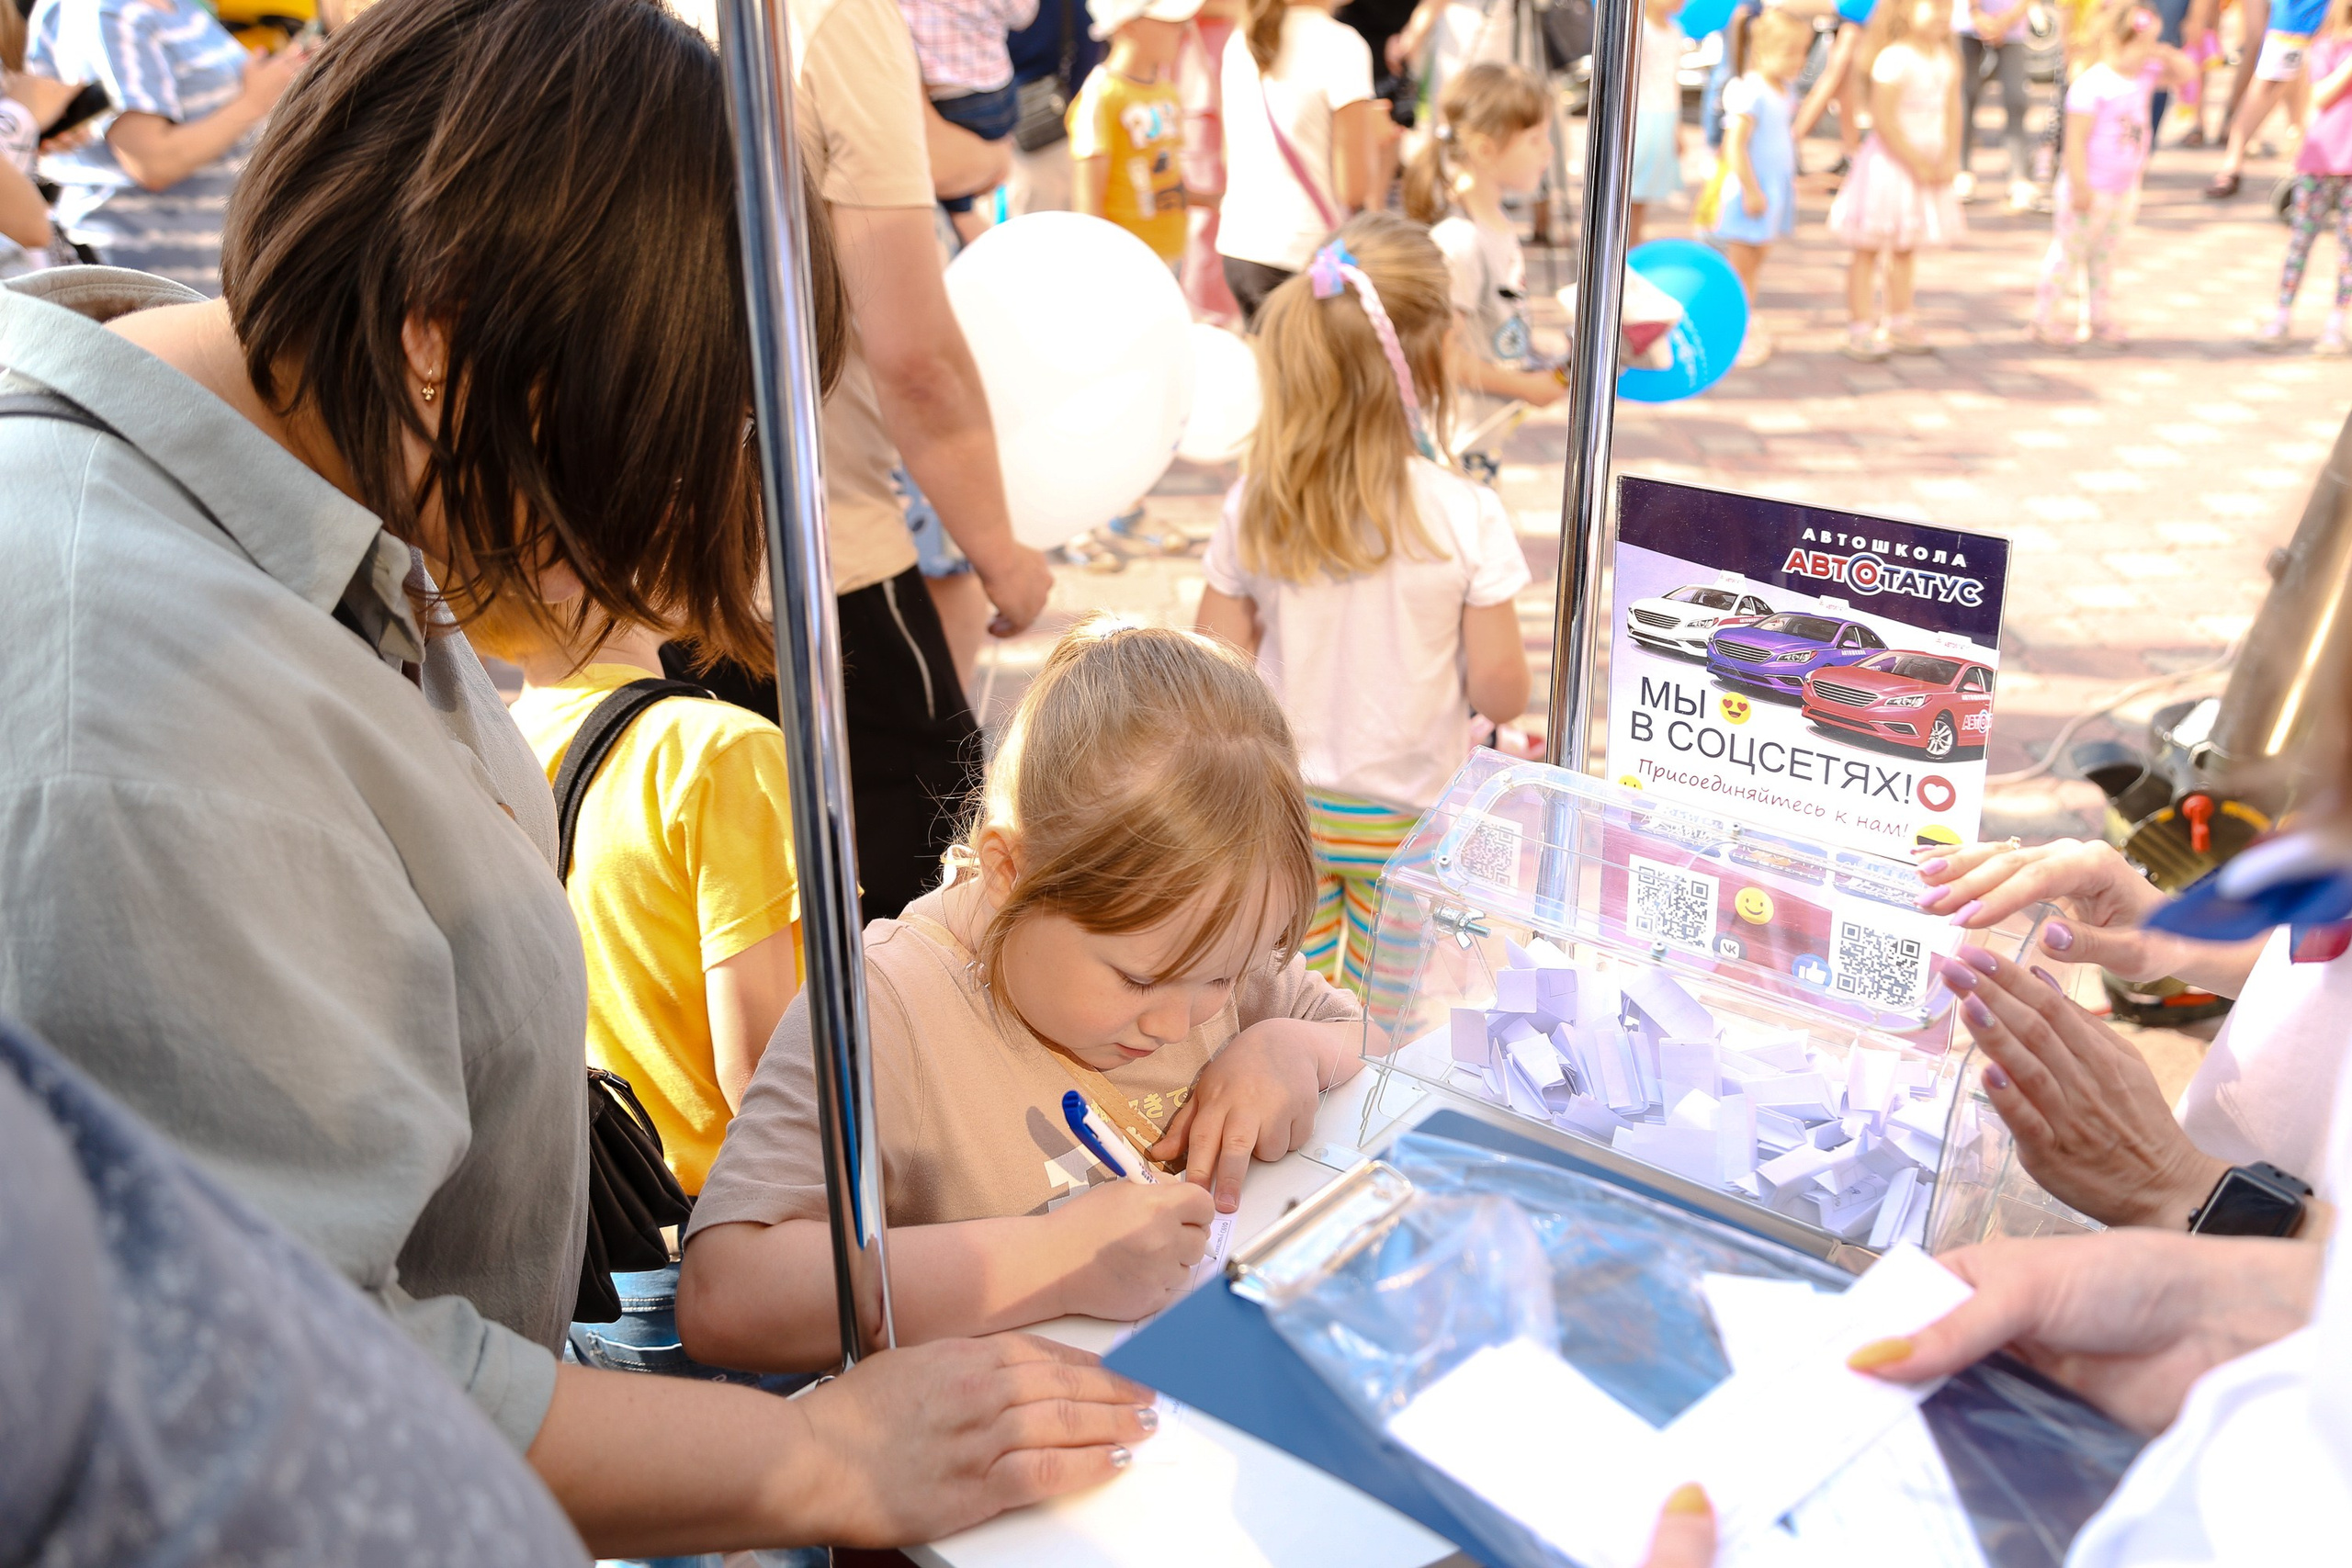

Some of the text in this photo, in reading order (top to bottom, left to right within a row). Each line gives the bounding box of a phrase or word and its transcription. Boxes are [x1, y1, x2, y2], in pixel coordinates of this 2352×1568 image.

[1781, 547, 1984, 607] АВТОСТАТУС
[1802, 528, 1967, 568] АВТОШКОЛА
[1641, 677, 1706, 719] МЫ
[1631, 710, 1912, 805] В СОЦСЕТЯХ!
[1638, 758, 1909, 839] Присоединяйтесь к нам!
